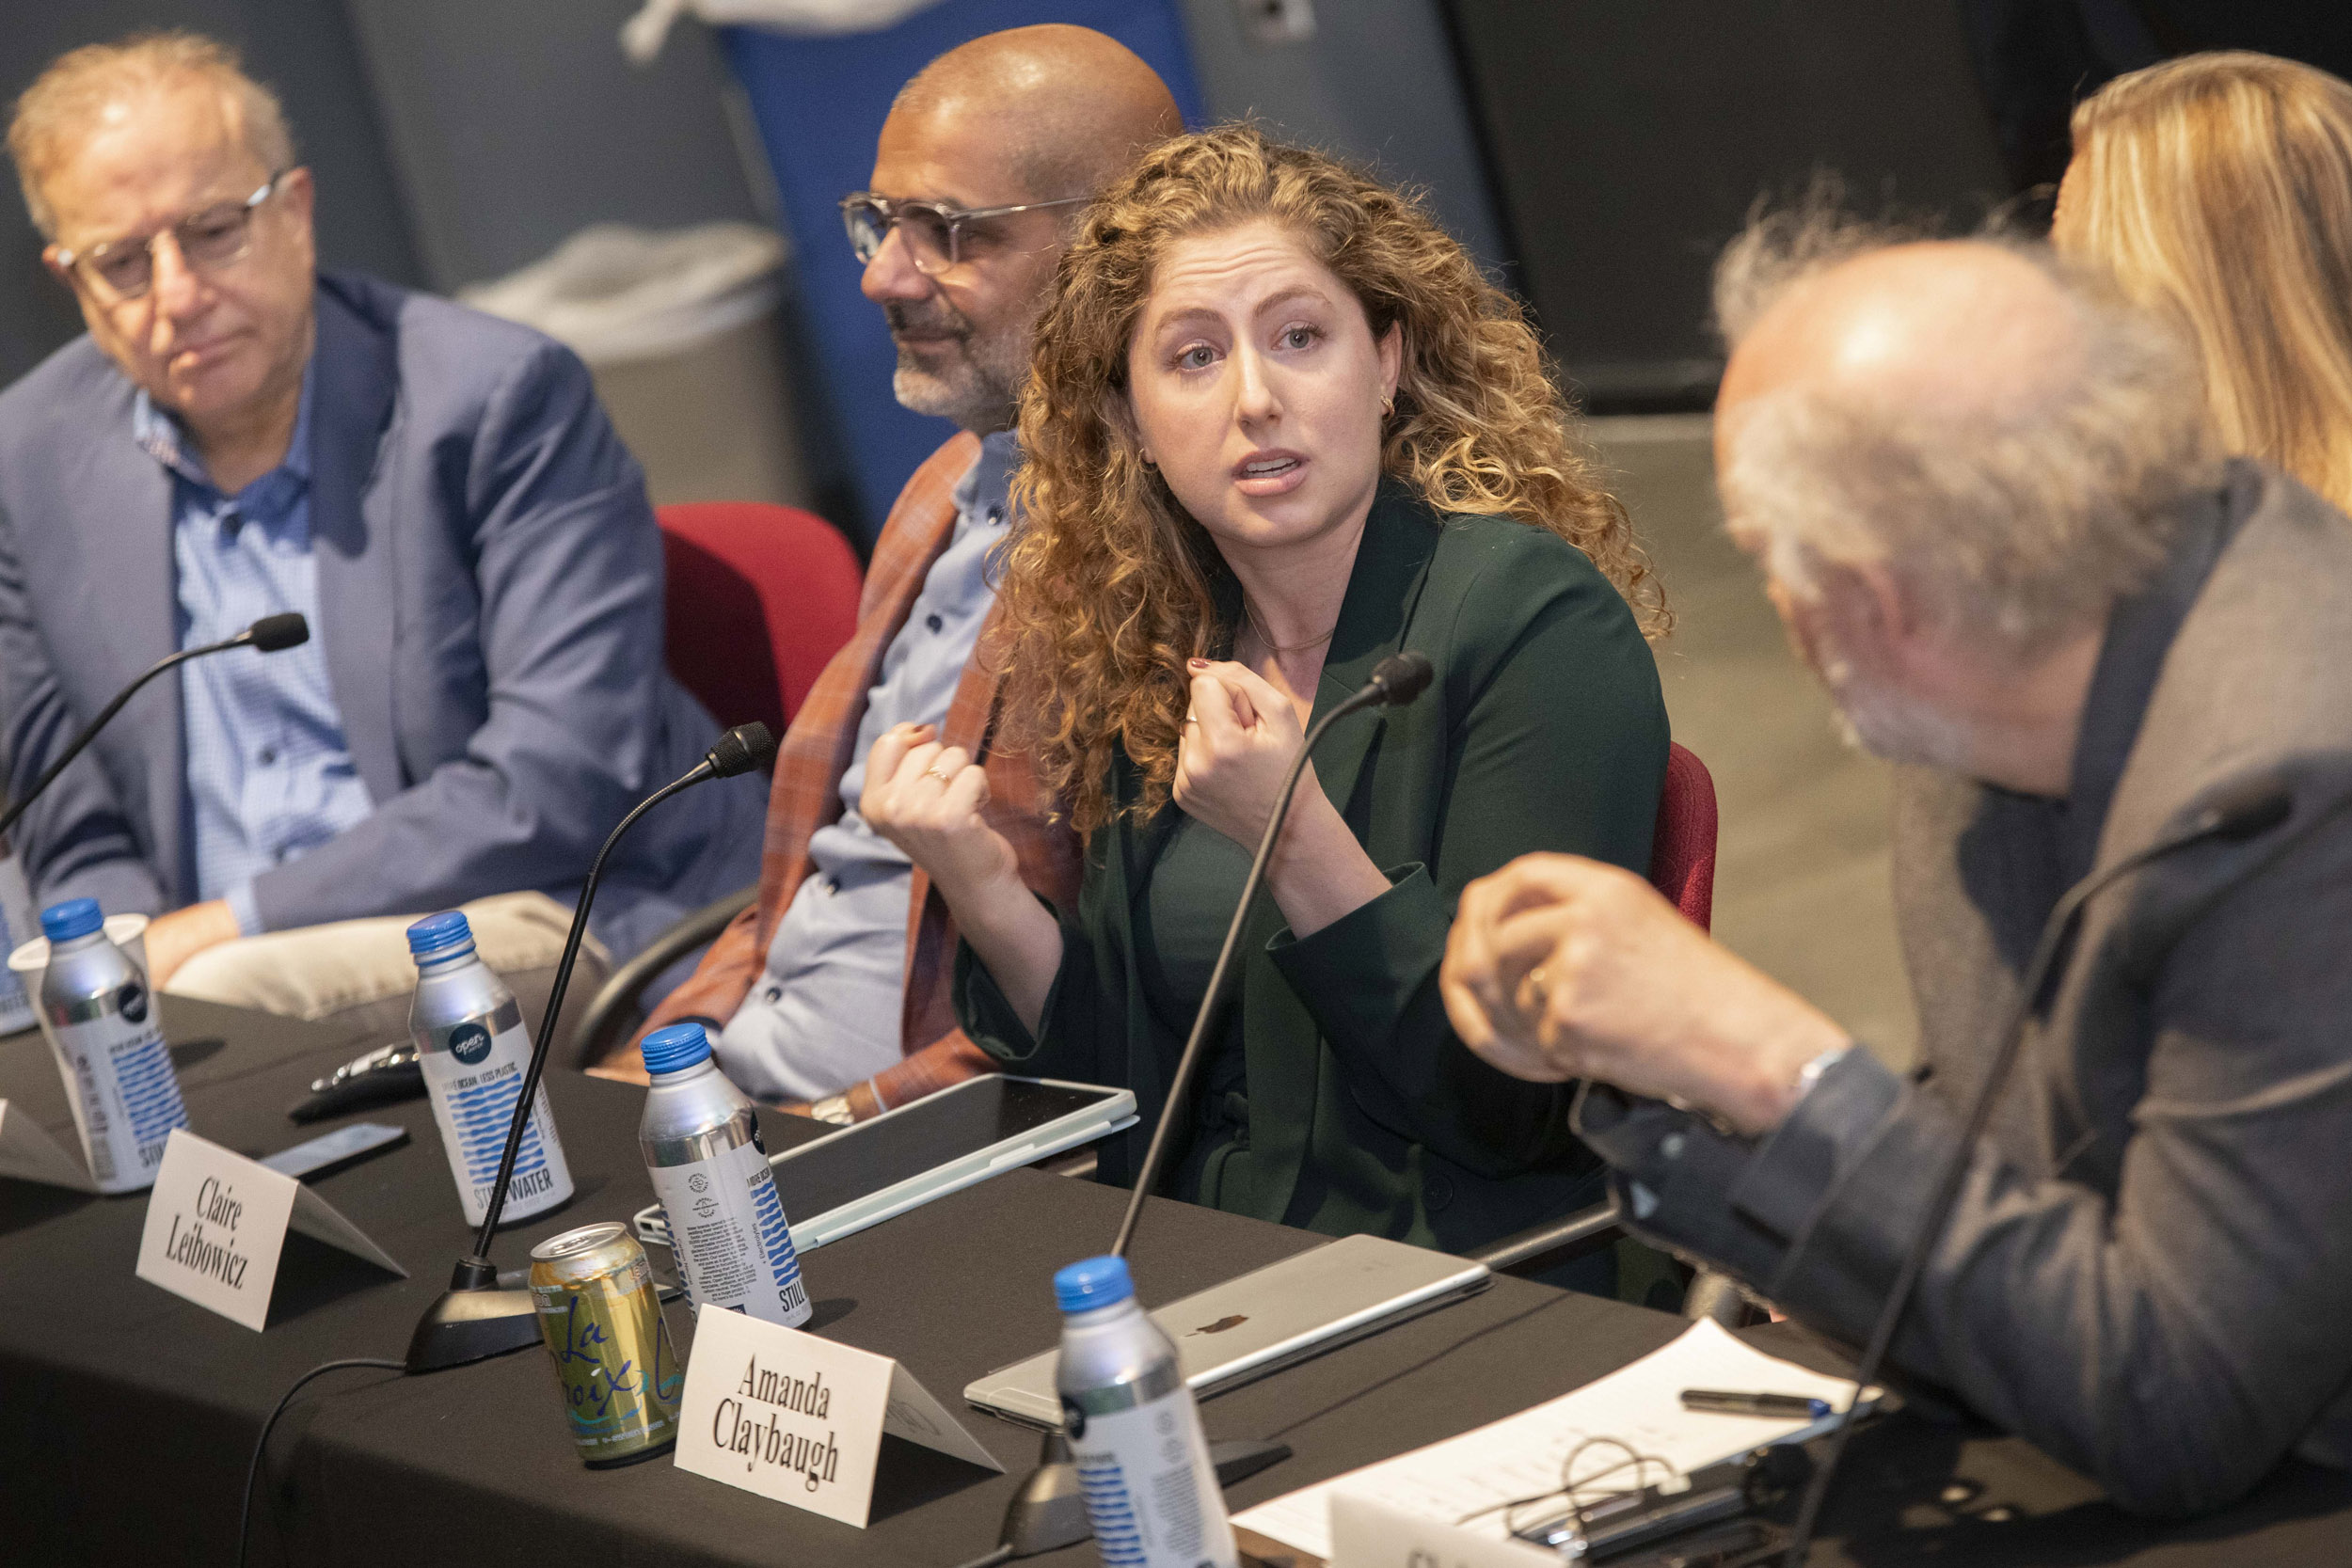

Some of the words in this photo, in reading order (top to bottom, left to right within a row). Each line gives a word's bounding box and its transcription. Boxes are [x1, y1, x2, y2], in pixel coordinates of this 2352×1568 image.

[455, 1033, 485, 1056] open
[480, 1069, 495, 1084] LESS
[196, 1176, 242, 1232] Claire
[509, 1168, 553, 1202] WATER
[165, 1212, 248, 1291] Leibowicz
[752, 1223, 766, 1259] Electrolytes
[779, 1281, 804, 1312] STILL
[560, 1295, 609, 1364] La
[738, 1353, 832, 1420] Amanda
[712, 1398, 840, 1493] Claybaugh
